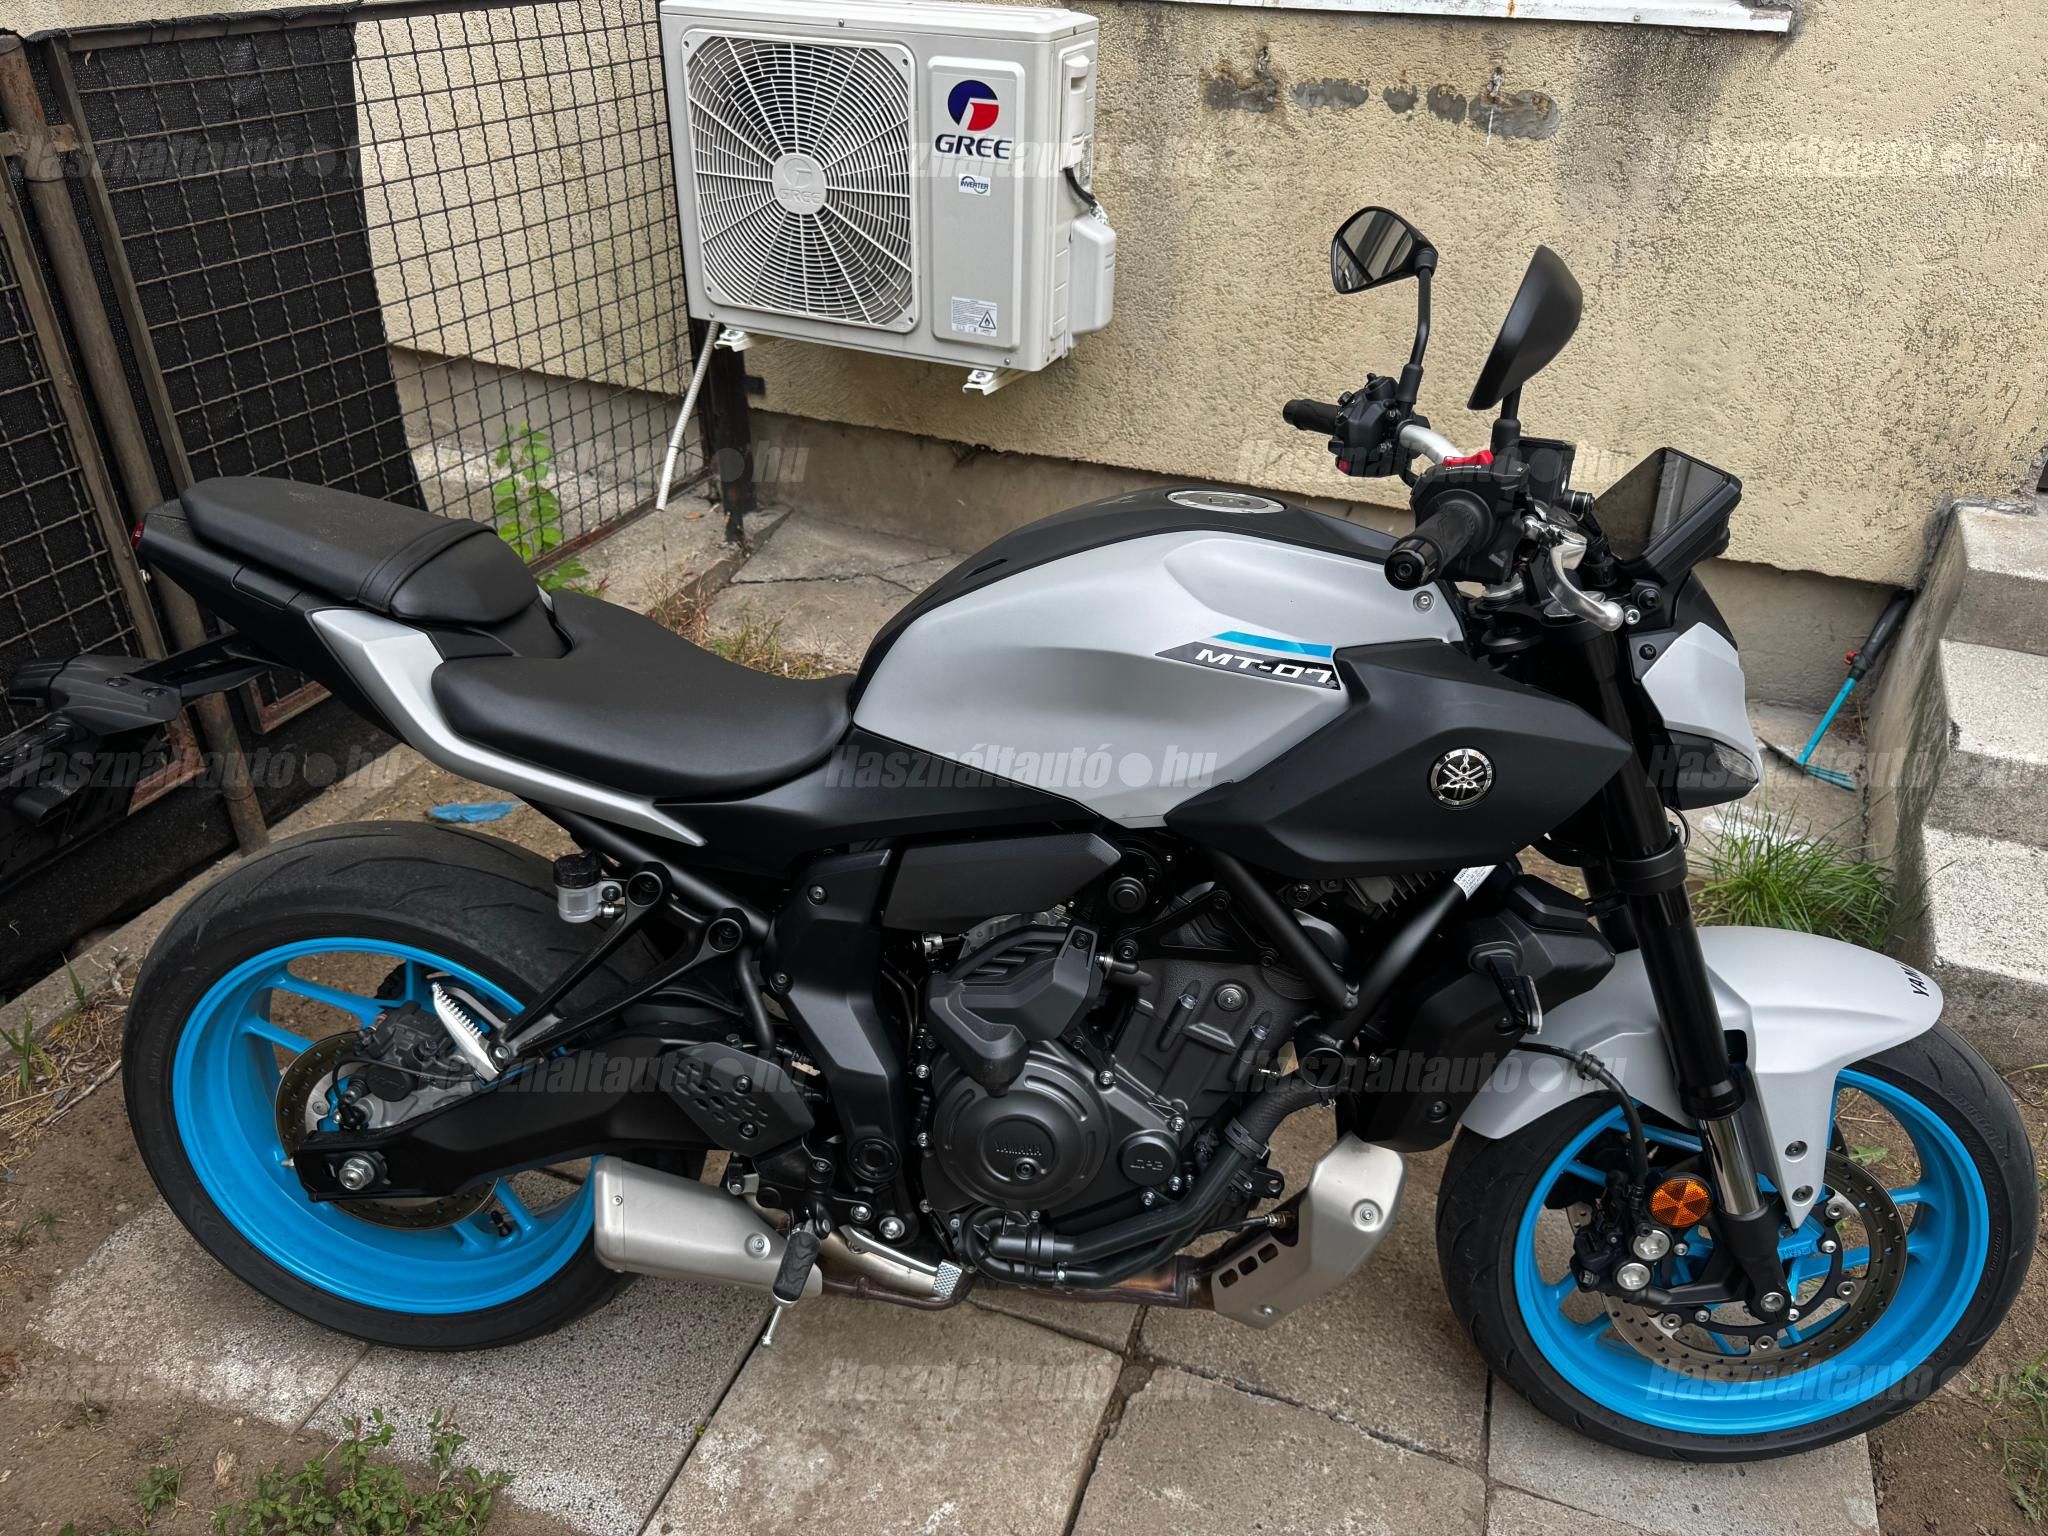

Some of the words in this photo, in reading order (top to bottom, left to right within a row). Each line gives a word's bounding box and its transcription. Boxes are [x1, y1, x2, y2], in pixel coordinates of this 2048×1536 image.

[935, 134, 1012, 160] GREE
[960, 180, 989, 190] INVERTER
[1195, 648, 1333, 684] MT-07
